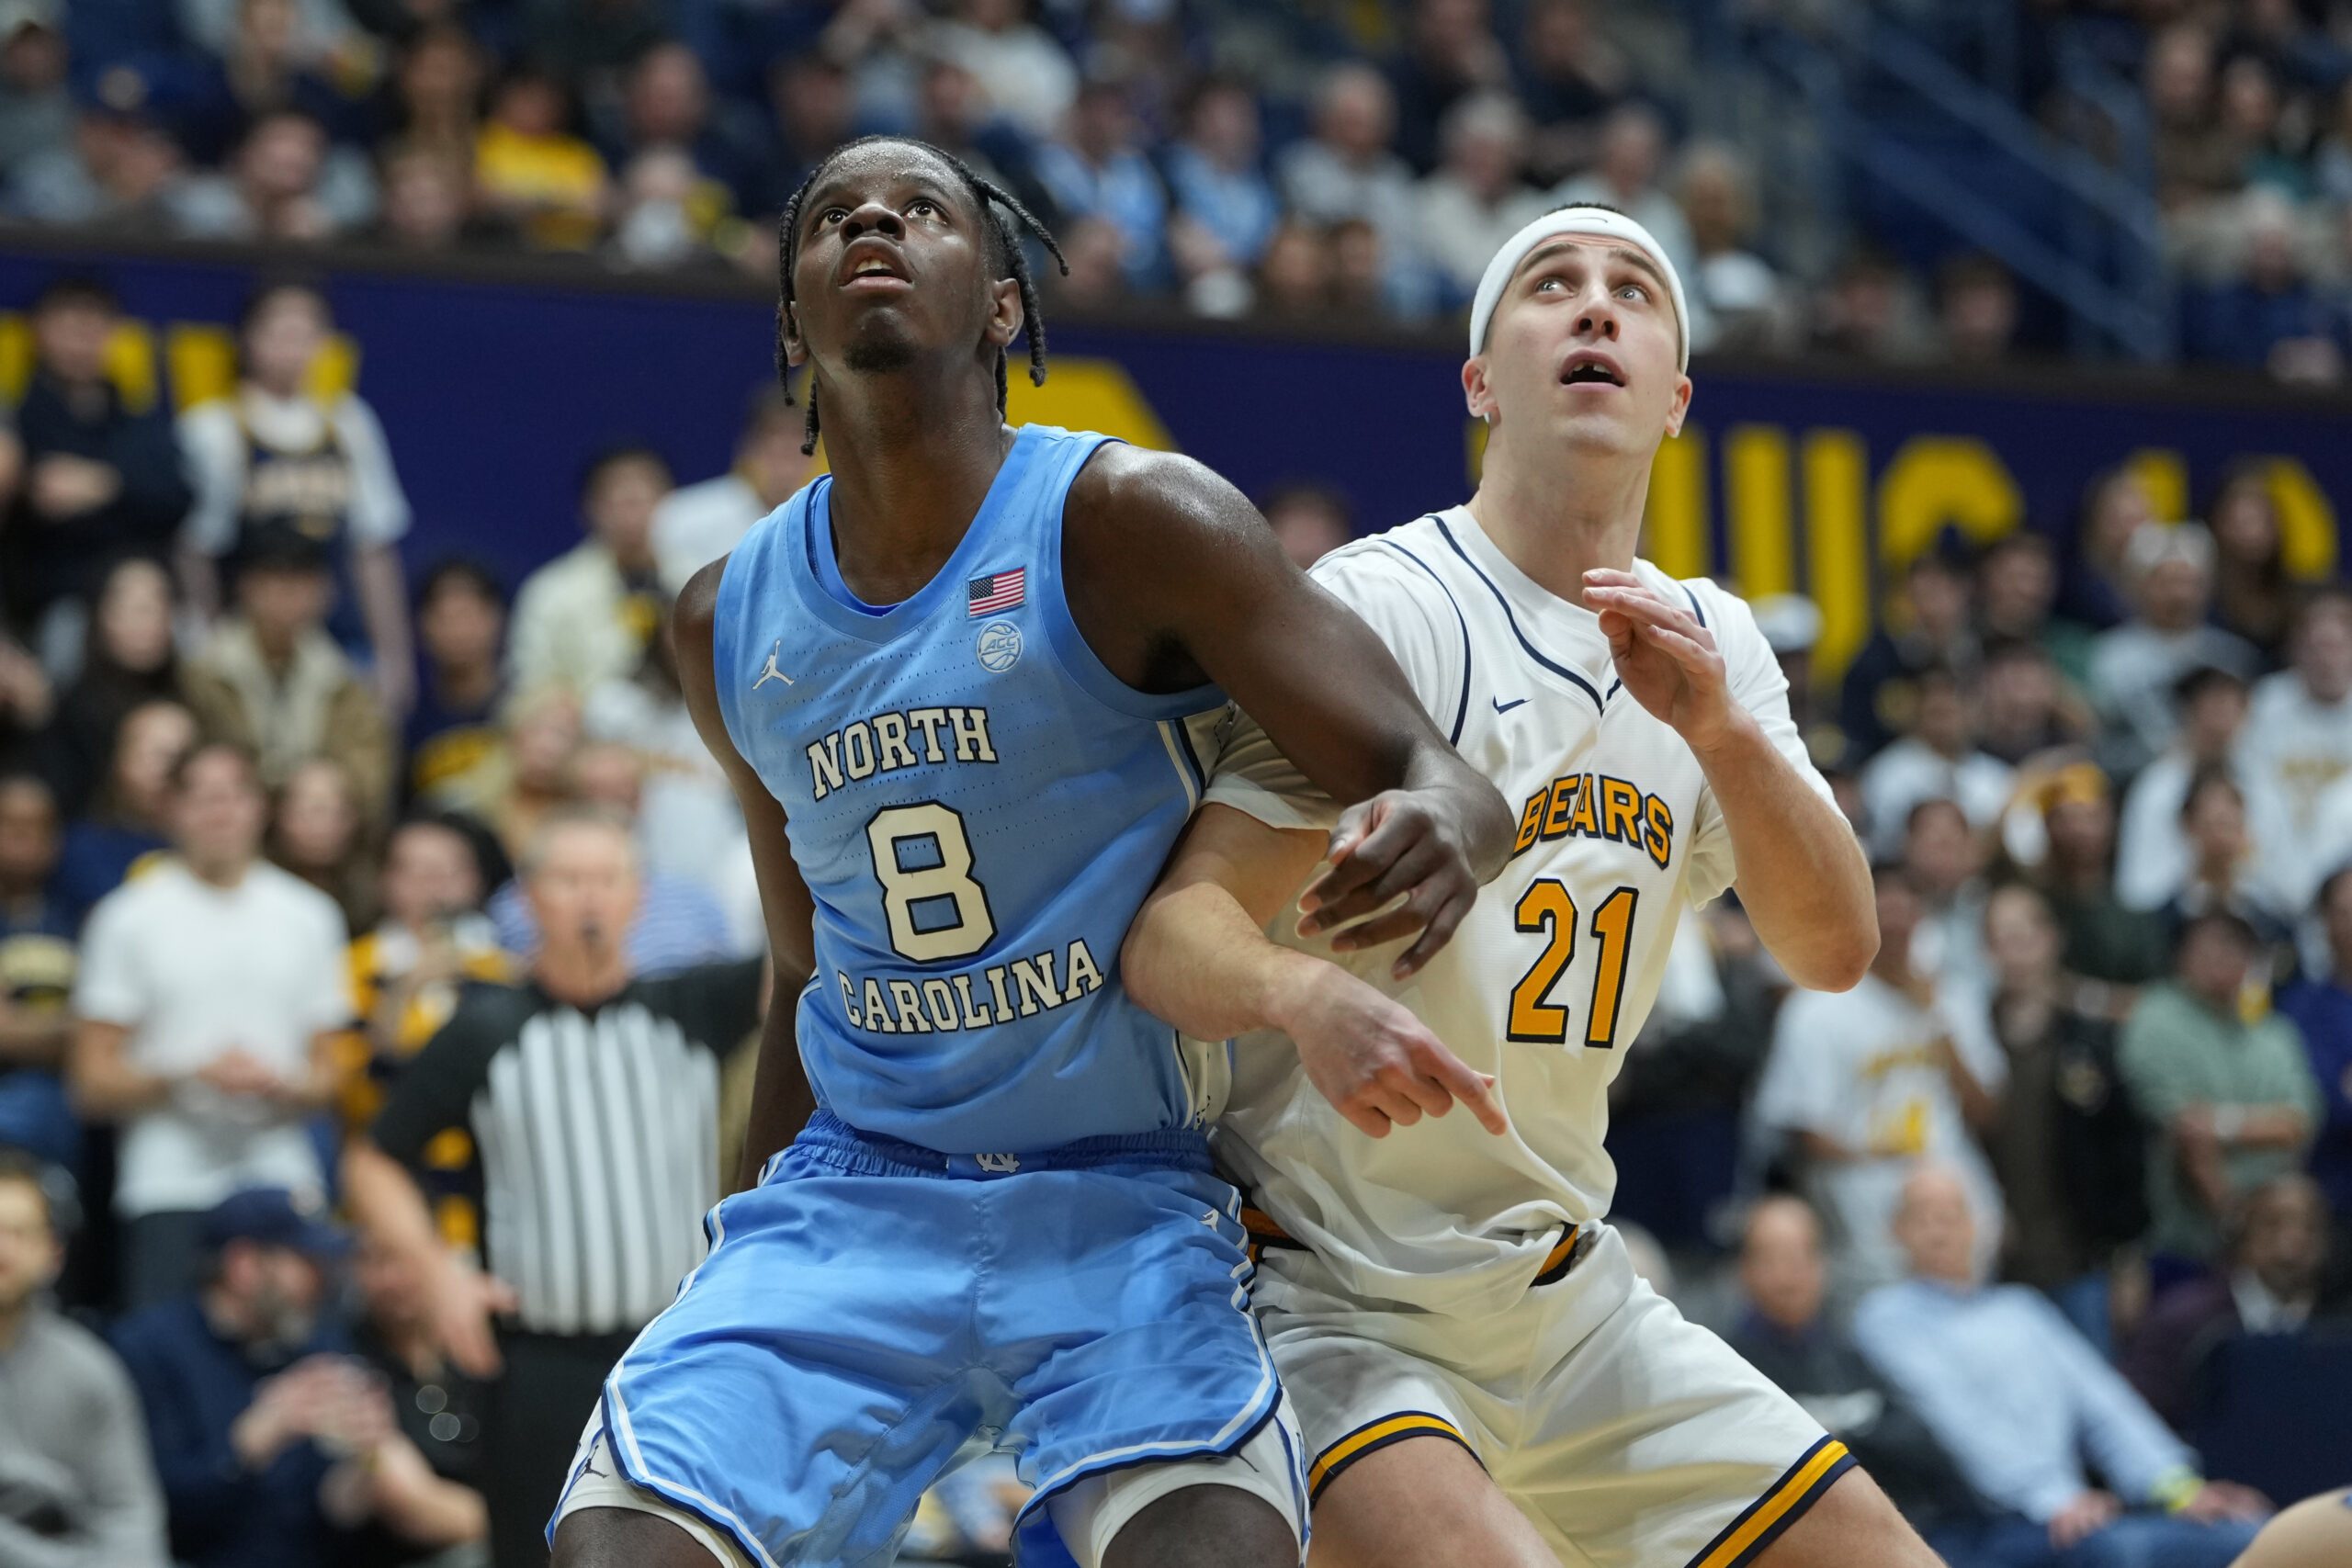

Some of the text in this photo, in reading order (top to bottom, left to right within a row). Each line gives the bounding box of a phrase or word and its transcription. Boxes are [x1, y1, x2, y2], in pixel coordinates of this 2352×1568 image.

[807, 706, 999, 802] NORTH
[1513, 773, 1674, 870] BEARS
[865, 799, 998, 964] 8
[837, 937, 1104, 1035] CAROLINA
[1506, 878, 1639, 1049] 21
